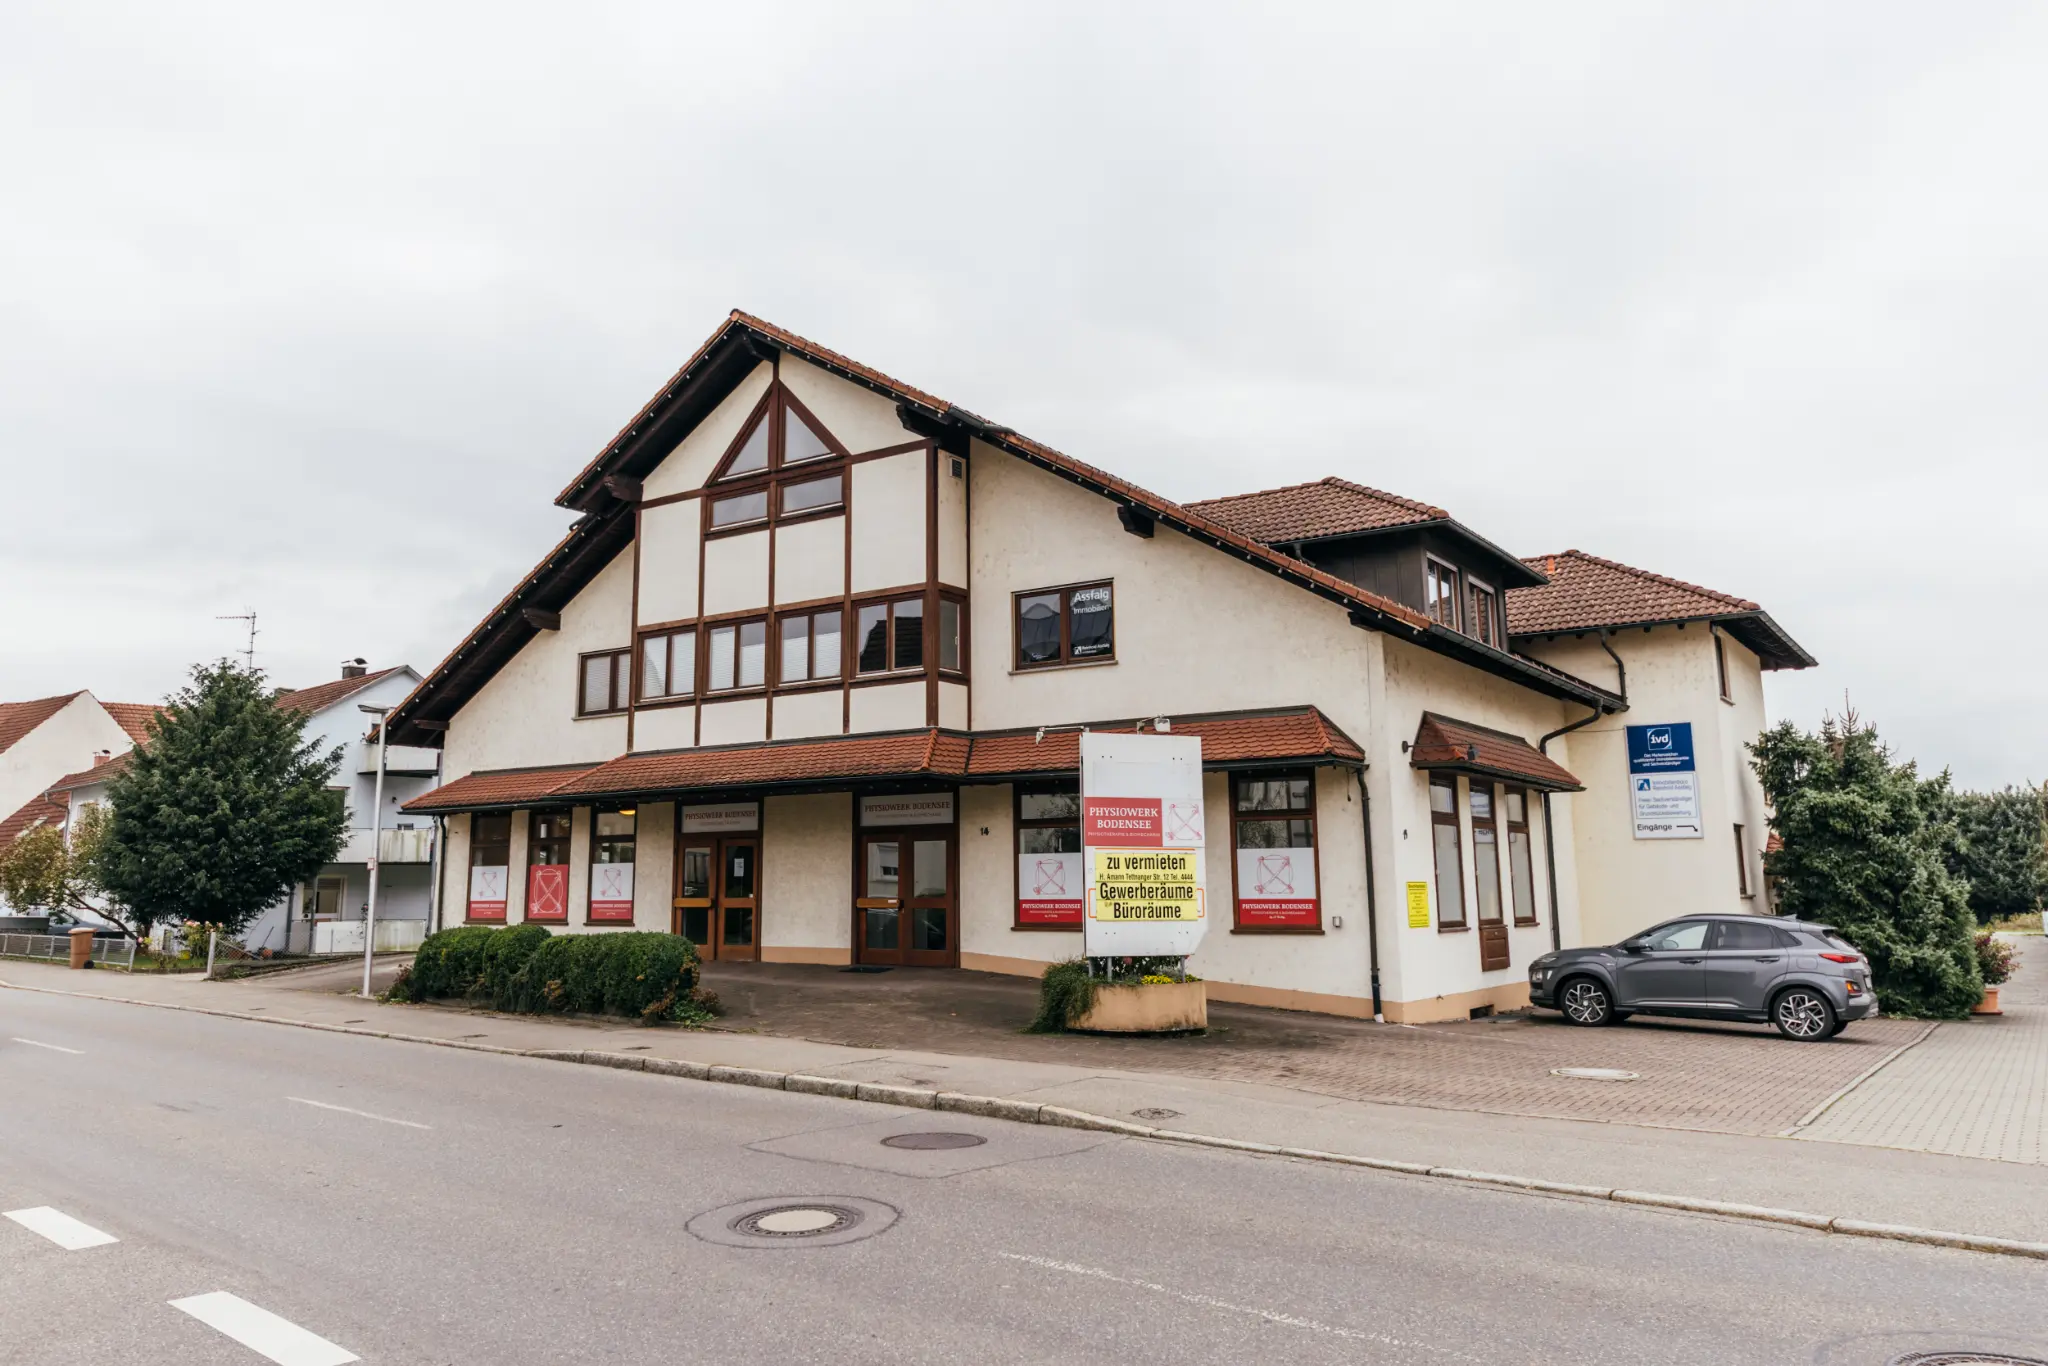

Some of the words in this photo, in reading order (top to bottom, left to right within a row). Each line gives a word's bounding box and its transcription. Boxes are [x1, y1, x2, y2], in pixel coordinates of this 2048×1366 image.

[1074, 588, 1109, 602] Assfalg
[1650, 733, 1669, 744] ivd
[864, 803, 911, 812] PHYSIOWERK
[912, 801, 950, 810] BODENSEE
[1089, 807, 1158, 817] PHYSIOWERK
[1097, 819, 1152, 829] BODENSEE
[1637, 823, 1672, 832] Eingänge
[980, 826, 990, 836] 14
[1107, 856, 1120, 870] zu
[1124, 854, 1186, 870] vermieten
[1100, 882, 1193, 899] Gewerberäume
[1113, 902, 1181, 919] Büroräume
